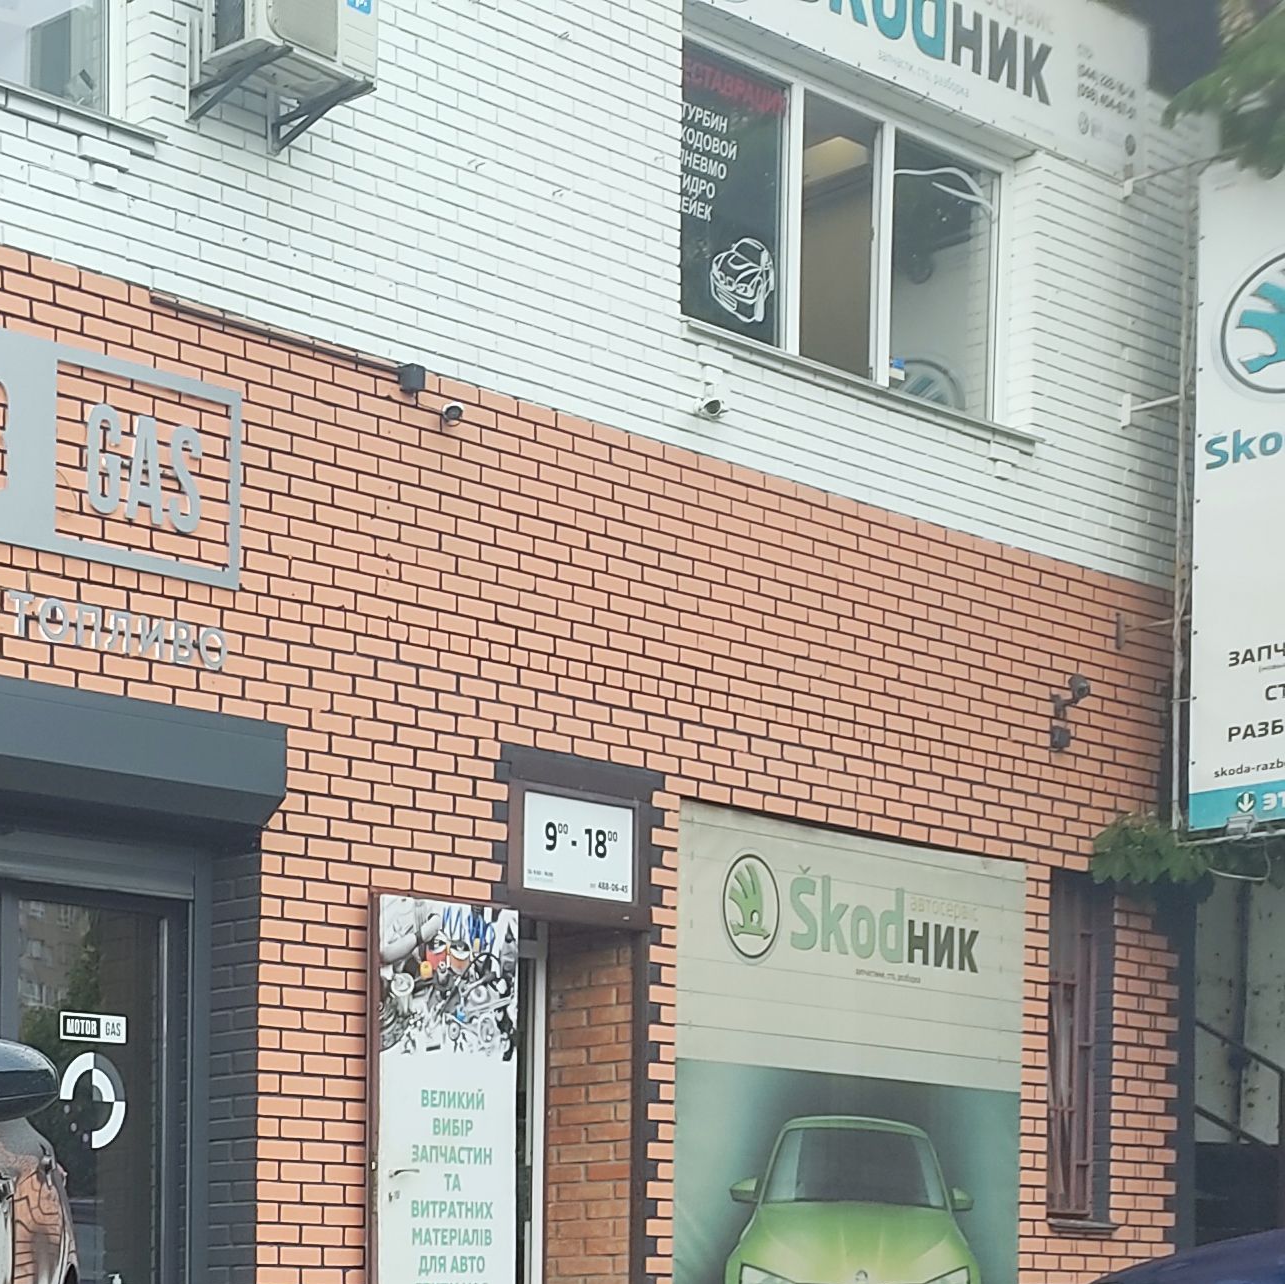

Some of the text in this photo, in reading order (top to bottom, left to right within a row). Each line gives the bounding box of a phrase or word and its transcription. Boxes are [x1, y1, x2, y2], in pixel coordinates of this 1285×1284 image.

[681, 101, 728, 133] ТУРБИН
[681, 172, 716, 200] ИДРО
[87, 403, 202, 534] GAS
[6, 589, 227, 672] ТОПЛИВО
[1228, 718, 1284, 742] РАЗБ
[1214, 757, 1285, 778] skoda-razb
[65, 1018, 121, 1037] MOTOR GAS
[420, 1088, 485, 1110] ВЕЛИКИЙ
[432, 1117, 473, 1137] ВИБІР
[411, 1144, 492, 1165] ЗАПЧАСТИН
[444, 1173, 461, 1192] ТА
[411, 1199, 493, 1220] ВИТРАТНИХ
[411, 1227, 493, 1247] МАТЕРІАЛІВ
[418, 1255, 485, 1276] ДЛЯ АВТО
